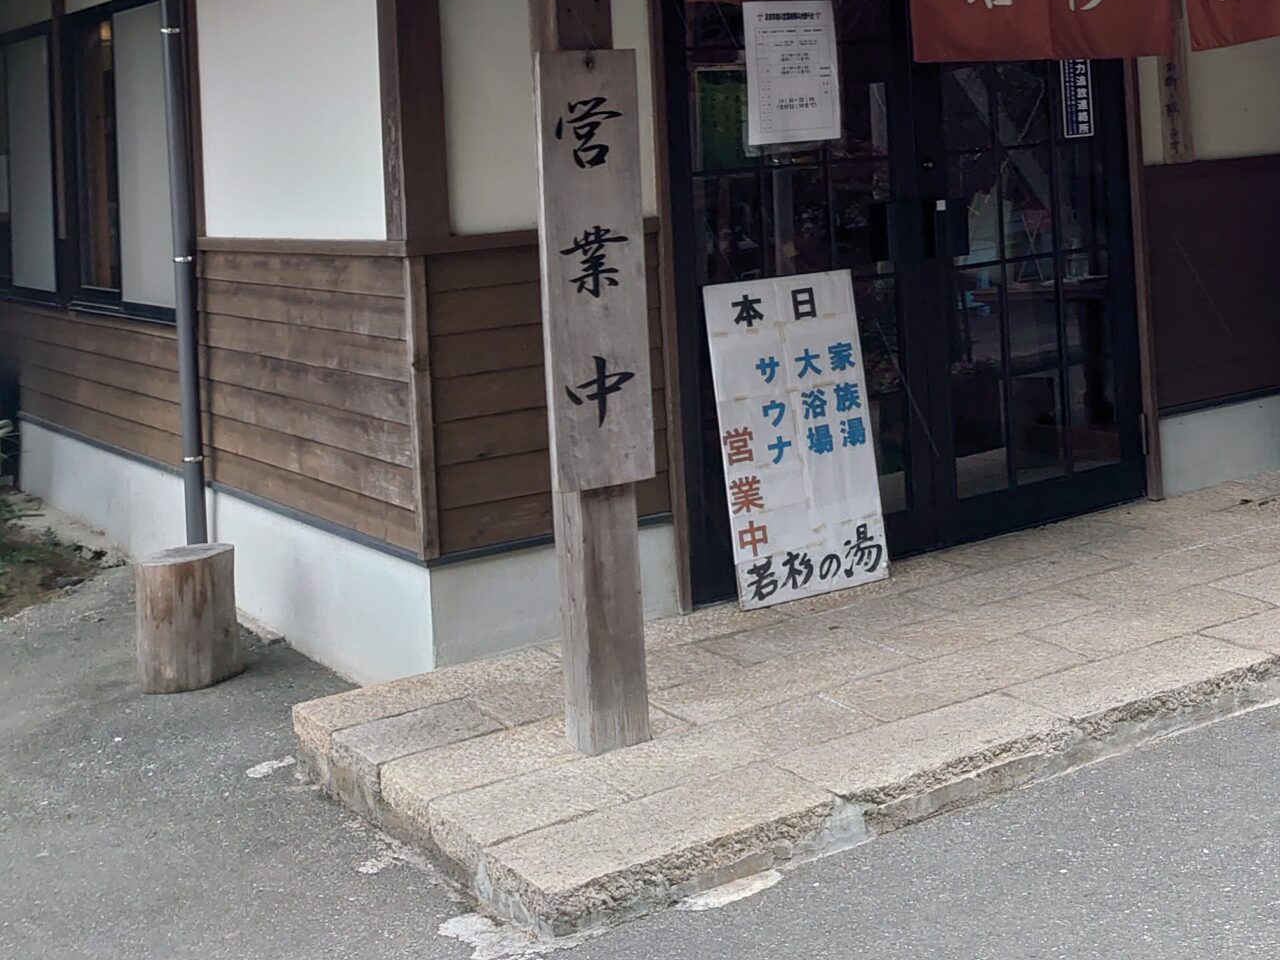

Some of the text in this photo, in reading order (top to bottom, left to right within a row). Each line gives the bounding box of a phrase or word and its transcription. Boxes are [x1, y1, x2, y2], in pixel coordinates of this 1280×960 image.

[1074, 59, 1090, 135] 力追放連絡所
[555, 95, 636, 429] 営業中
[731, 287, 818, 327] 本日
[755, 356, 793, 465] サウナ
[794, 348, 834, 455] 大浴場
[827, 342, 866, 448] 家族湯
[722, 426, 769, 558] 営業中
[746, 523, 883, 602] 若杉の湯
